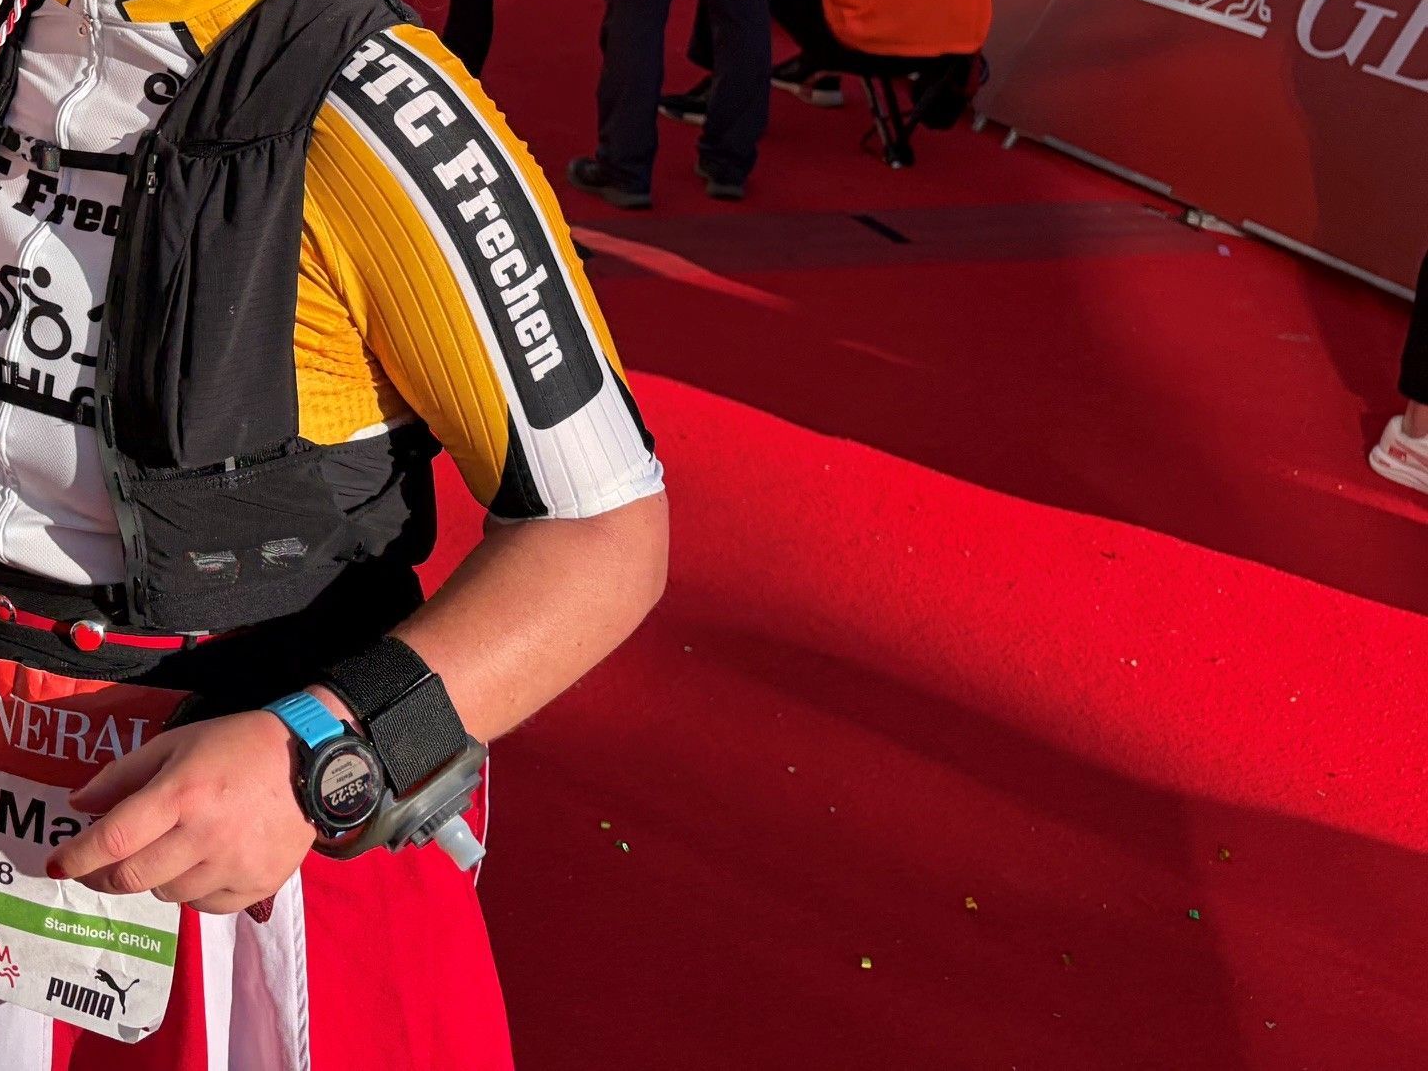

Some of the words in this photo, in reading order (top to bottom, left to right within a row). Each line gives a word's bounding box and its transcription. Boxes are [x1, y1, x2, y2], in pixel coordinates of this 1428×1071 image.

[431, 137, 565, 383] Frechen
[44, 916, 115, 942] Startblock
[118, 931, 162, 954] GRÜN
[45, 976, 116, 1022] PUMA
